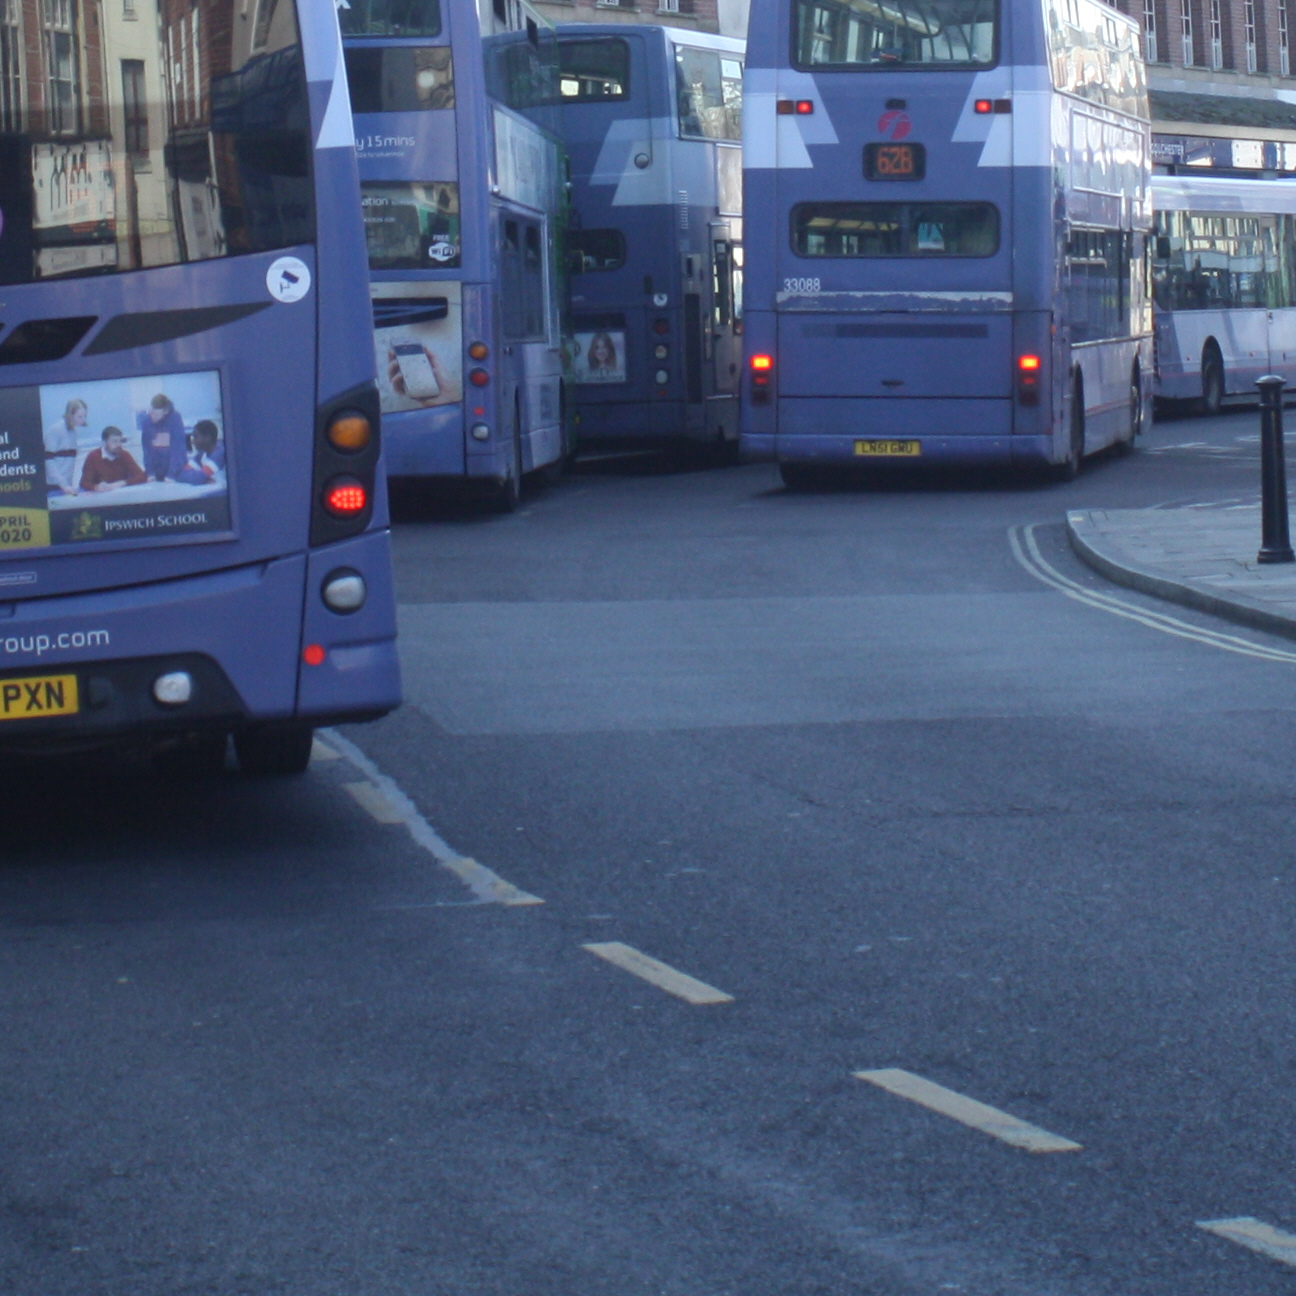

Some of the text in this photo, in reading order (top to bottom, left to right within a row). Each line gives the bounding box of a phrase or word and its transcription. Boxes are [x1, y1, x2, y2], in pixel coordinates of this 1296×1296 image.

[783, 278, 821, 292] 33088
[104, 512, 209, 532] IPSWICH SCHOOL
[2, 679, 66, 714] PXN
